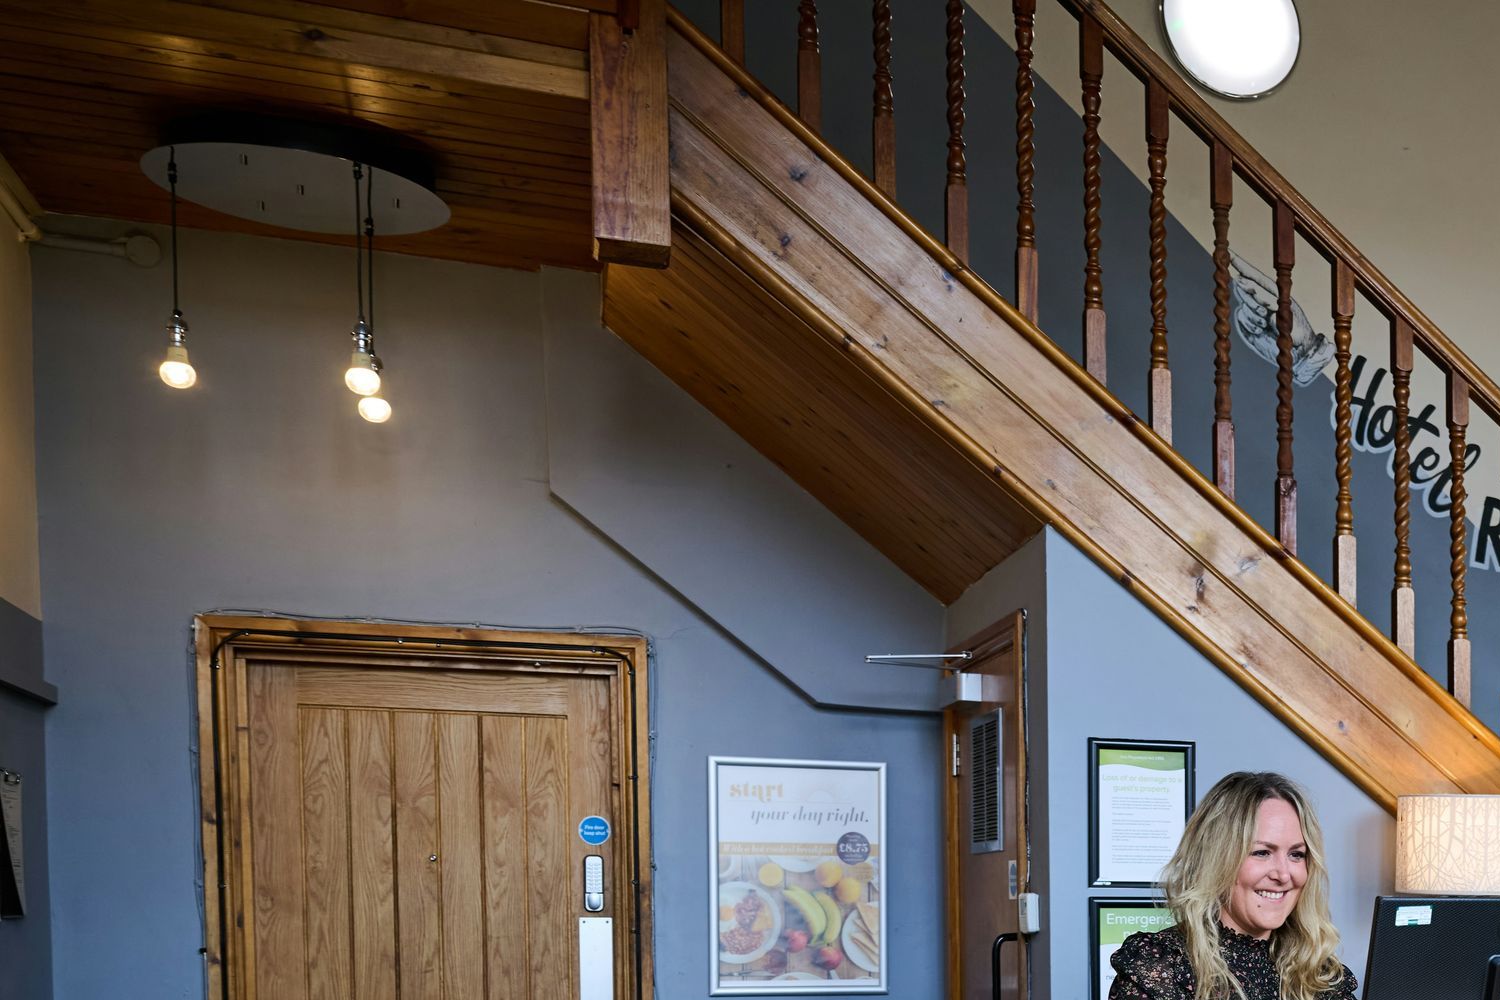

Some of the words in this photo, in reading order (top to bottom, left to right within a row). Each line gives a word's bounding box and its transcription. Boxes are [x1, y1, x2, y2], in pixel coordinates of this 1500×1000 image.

[1340, 355, 1481, 513] Hotel
[729, 782, 784, 803] start
[751, 809, 790, 825] your
[792, 806, 823, 826] day
[826, 807, 869, 827] right.
[839, 843, 869, 853] £8.75
[1106, 913, 1174, 928] Emergenc
